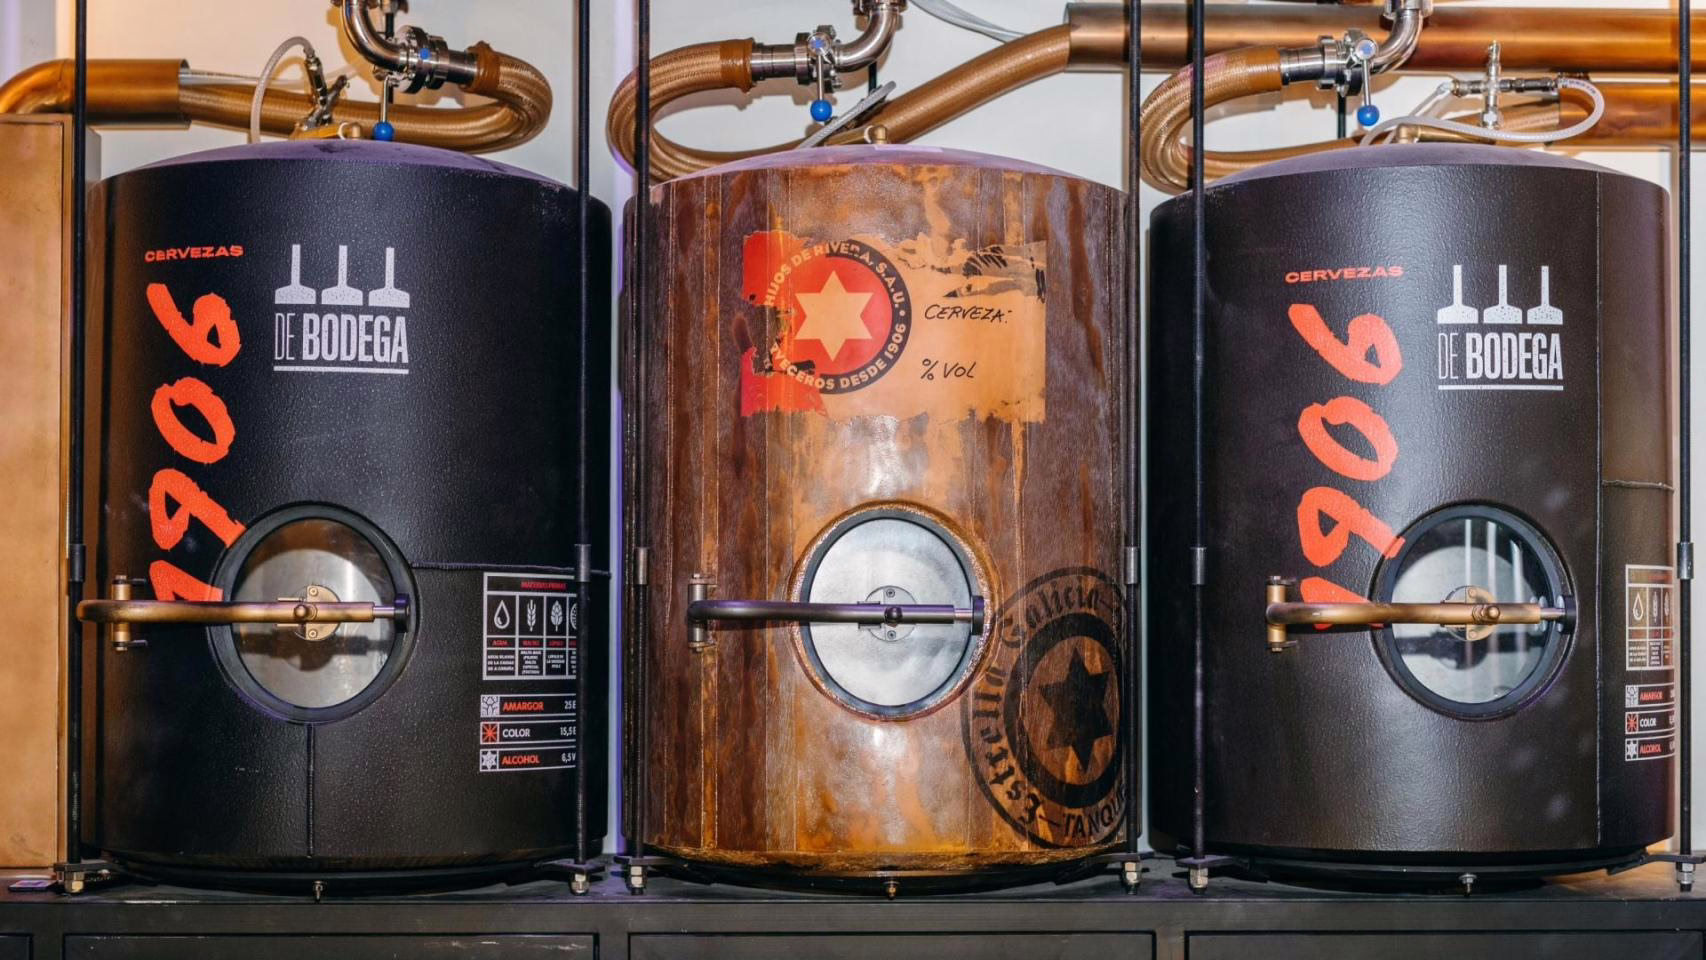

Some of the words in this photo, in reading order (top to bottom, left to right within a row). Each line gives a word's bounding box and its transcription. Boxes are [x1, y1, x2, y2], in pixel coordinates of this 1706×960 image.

[144, 245, 244, 262] CERVEZAS
[763, 263, 792, 307] HIJOS
[791, 248, 812, 267] DE
[1285, 266, 1404, 283] CERVEZAS
[274, 313, 296, 360] DE
[302, 313, 409, 363] BODEGA
[840, 358, 887, 388] DESDE
[884, 323, 906, 360] 1906
[1437, 333, 1459, 380] DE
[1465, 332, 1563, 380] BODEGA
[920, 358, 939, 380] %
[503, 702, 544, 711] AMARGOR
[1639, 717, 1657, 728] COLOR
[502, 728, 531, 738] COLOR
[502, 754, 540, 765] ALCOHOL
